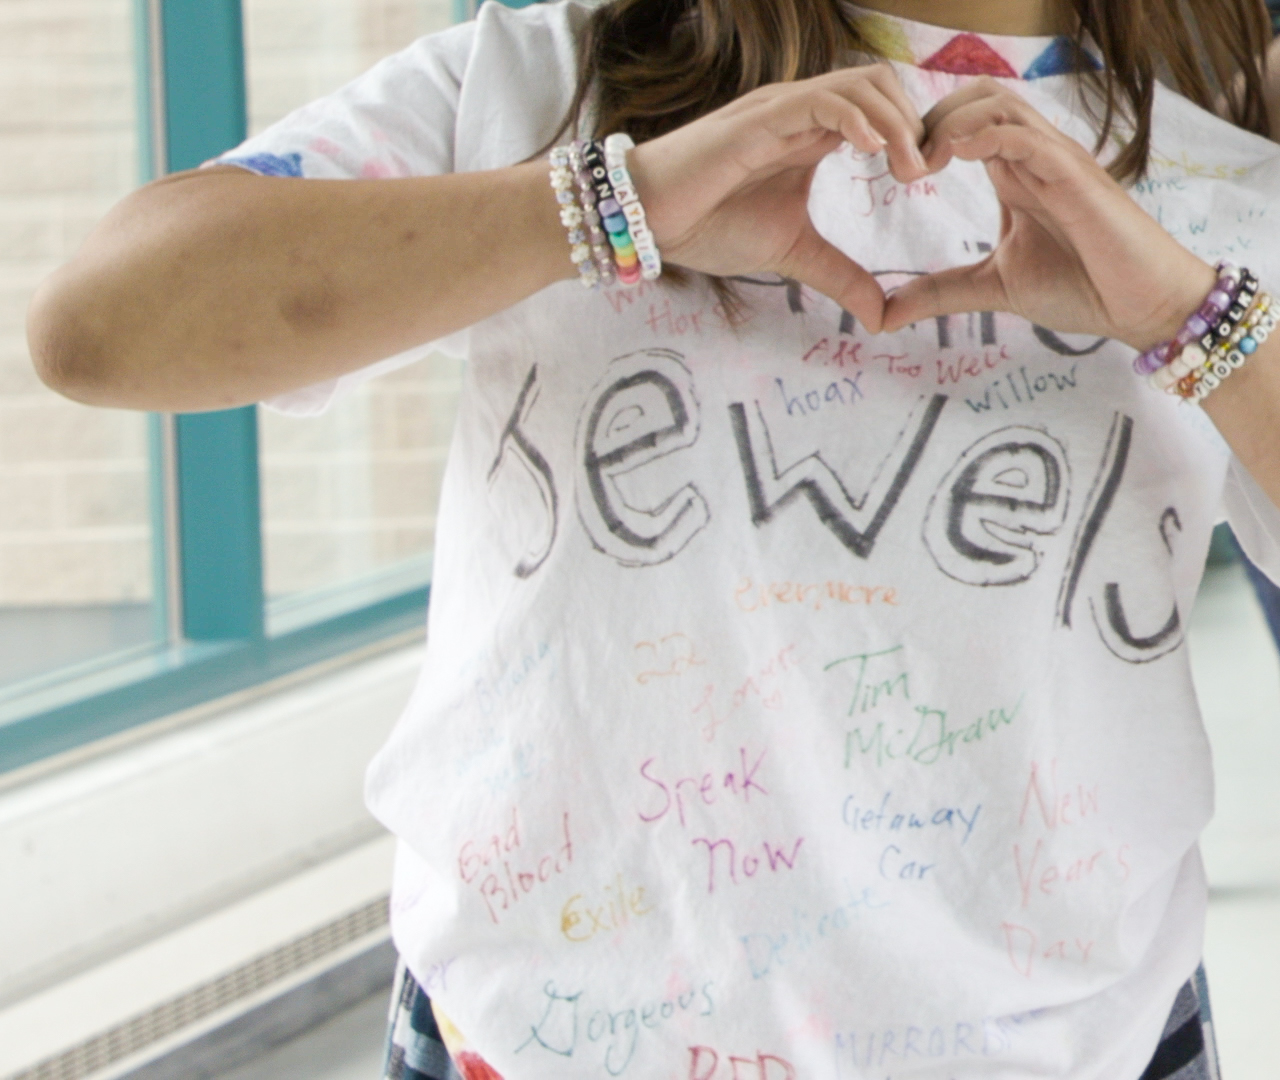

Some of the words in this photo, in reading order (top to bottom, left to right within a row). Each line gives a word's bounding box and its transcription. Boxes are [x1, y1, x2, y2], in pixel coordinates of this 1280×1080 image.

[1201, 278, 1256, 350] FOLKL
[774, 371, 865, 417] hoax
[873, 353, 922, 379] Too
[937, 344, 1012, 385] Well
[965, 362, 1081, 415] willow
[633, 630, 706, 686] 22
[823, 644, 912, 718] Tim
[638, 747, 769, 828] Speak
[1018, 758, 1101, 831] New
[878, 844, 937, 883] Car
[1001, 921, 1096, 980] Day
[513, 980, 716, 1077] Gorgeous
